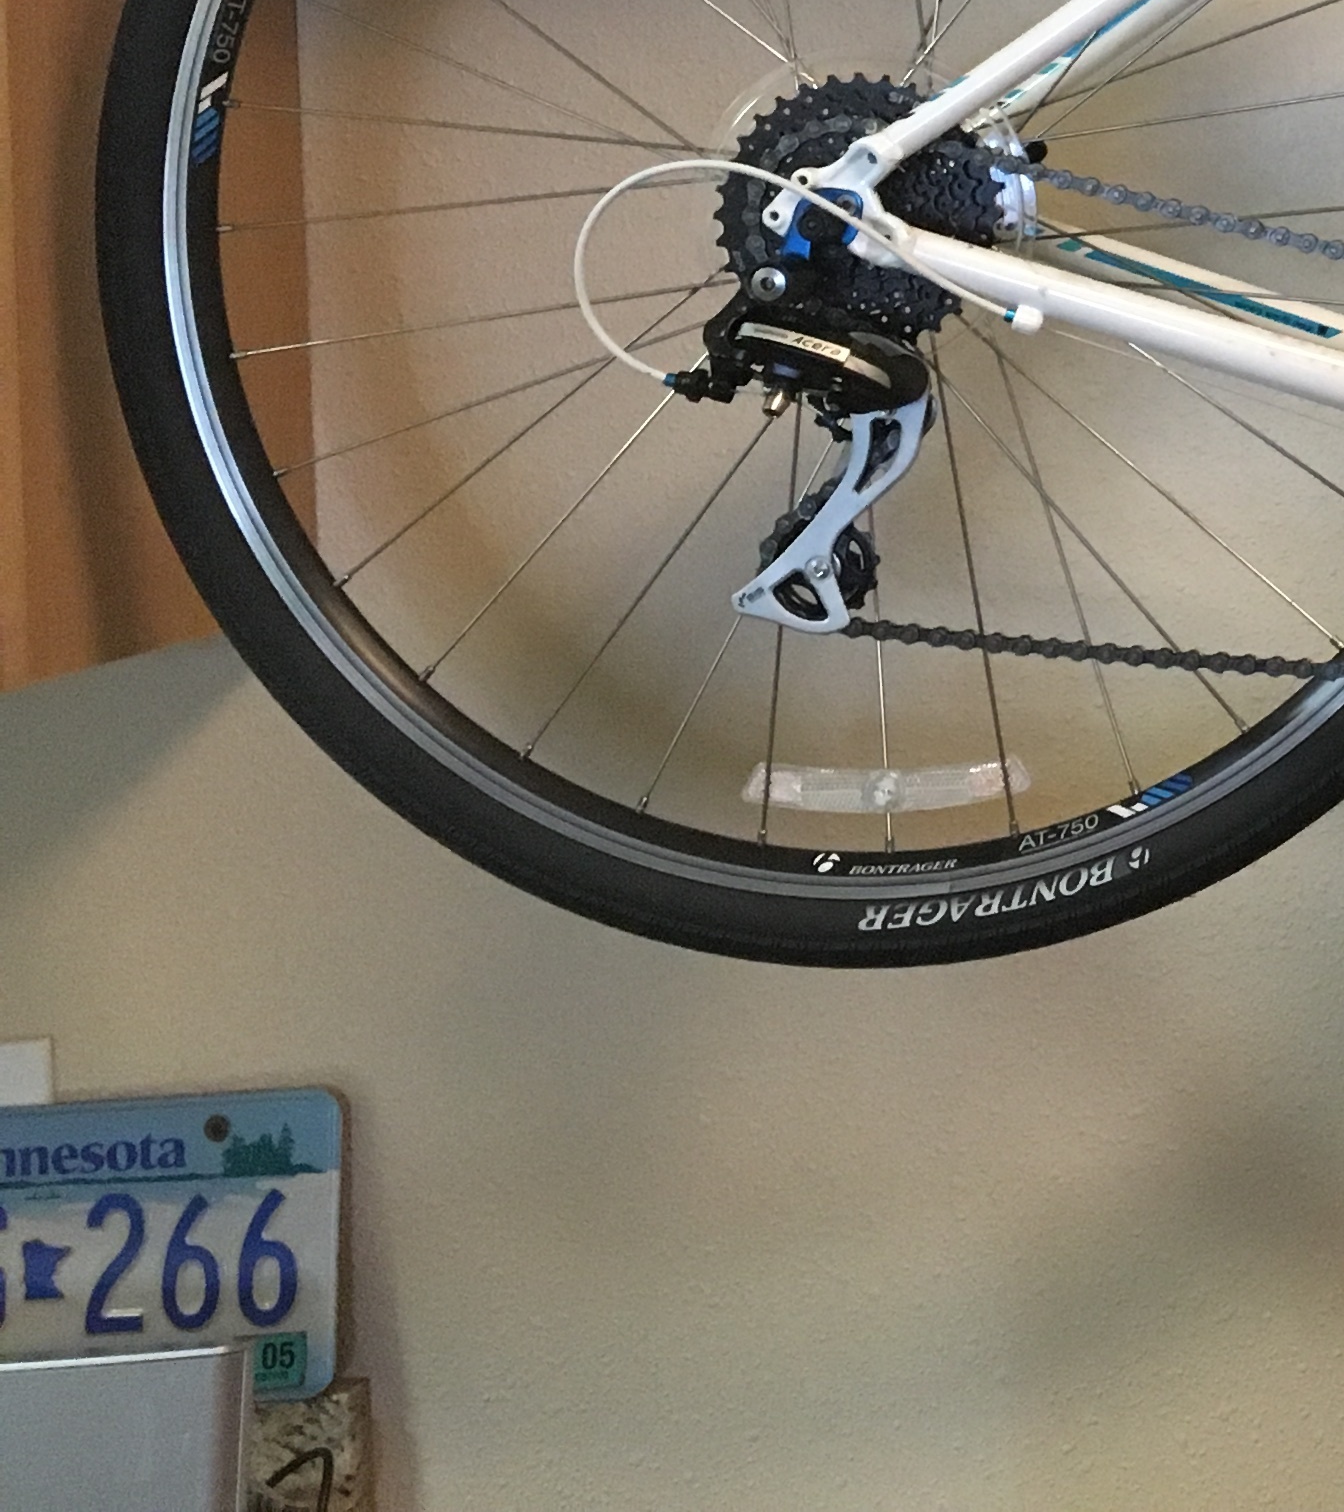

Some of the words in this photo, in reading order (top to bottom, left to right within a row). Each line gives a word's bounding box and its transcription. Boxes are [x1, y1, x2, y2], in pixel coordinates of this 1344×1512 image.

[1018, 815, 1100, 853] AT-750
[848, 858, 958, 876] BONTRAGER
[858, 856, 1115, 932] BONTRAGER
[262, 1341, 295, 1369] 05
